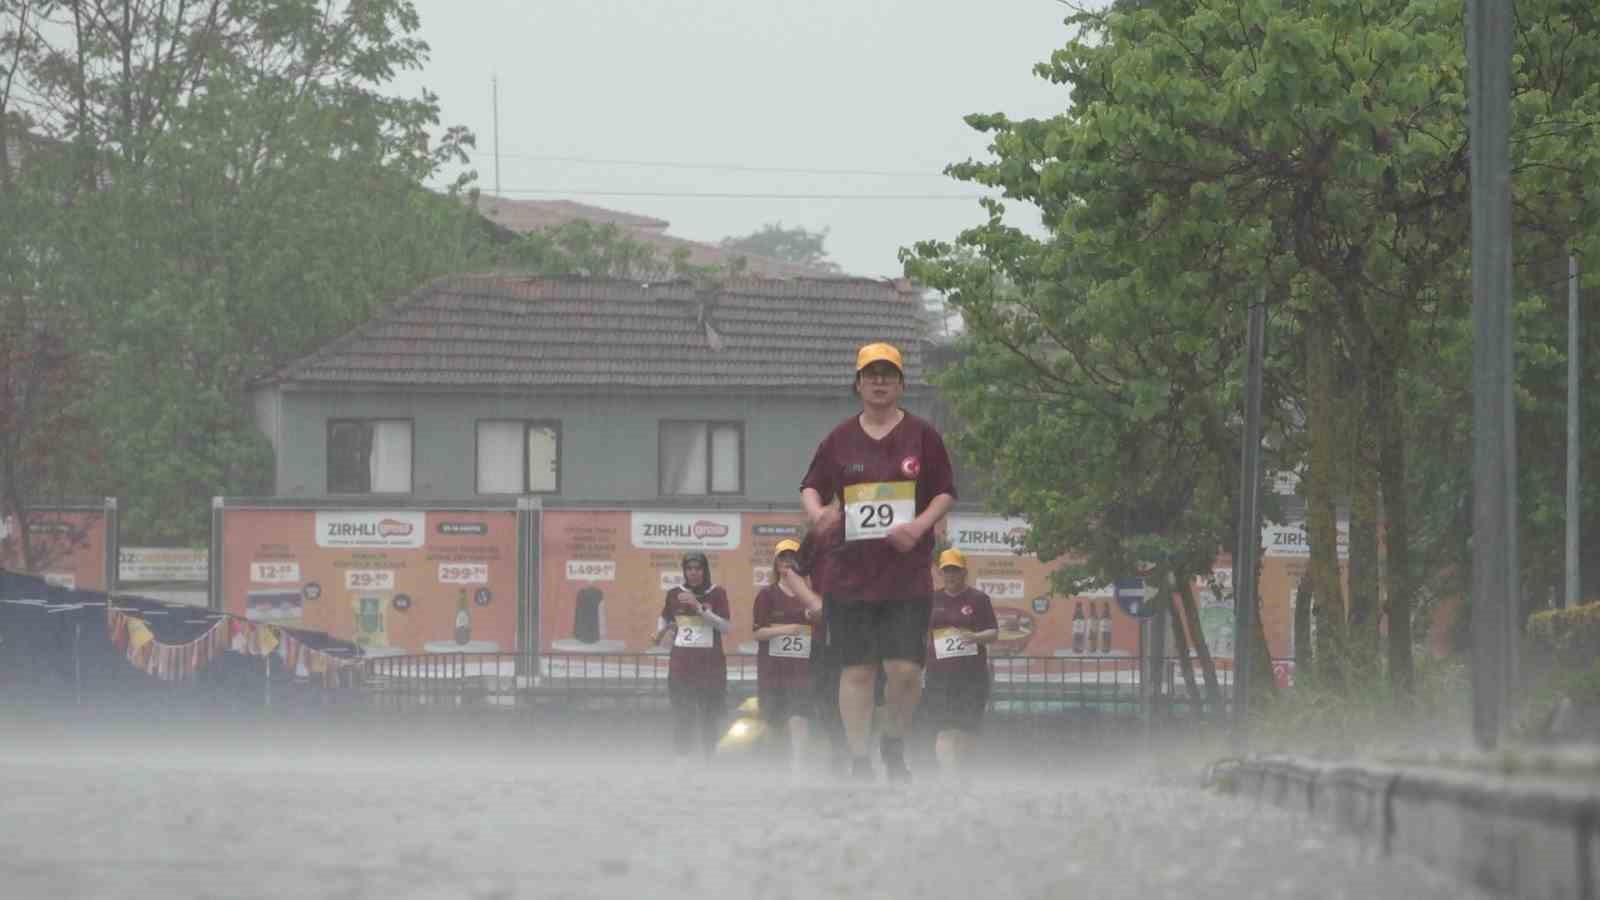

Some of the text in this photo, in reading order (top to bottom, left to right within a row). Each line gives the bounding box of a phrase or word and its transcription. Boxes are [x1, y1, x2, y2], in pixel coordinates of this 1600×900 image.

[859, 504, 895, 529] 29
[328, 522, 376, 536] ZIRHLI
[643, 524, 692, 537] ZIRHLI
[782, 636, 803, 652] 25
[945, 638, 966, 651] 22
